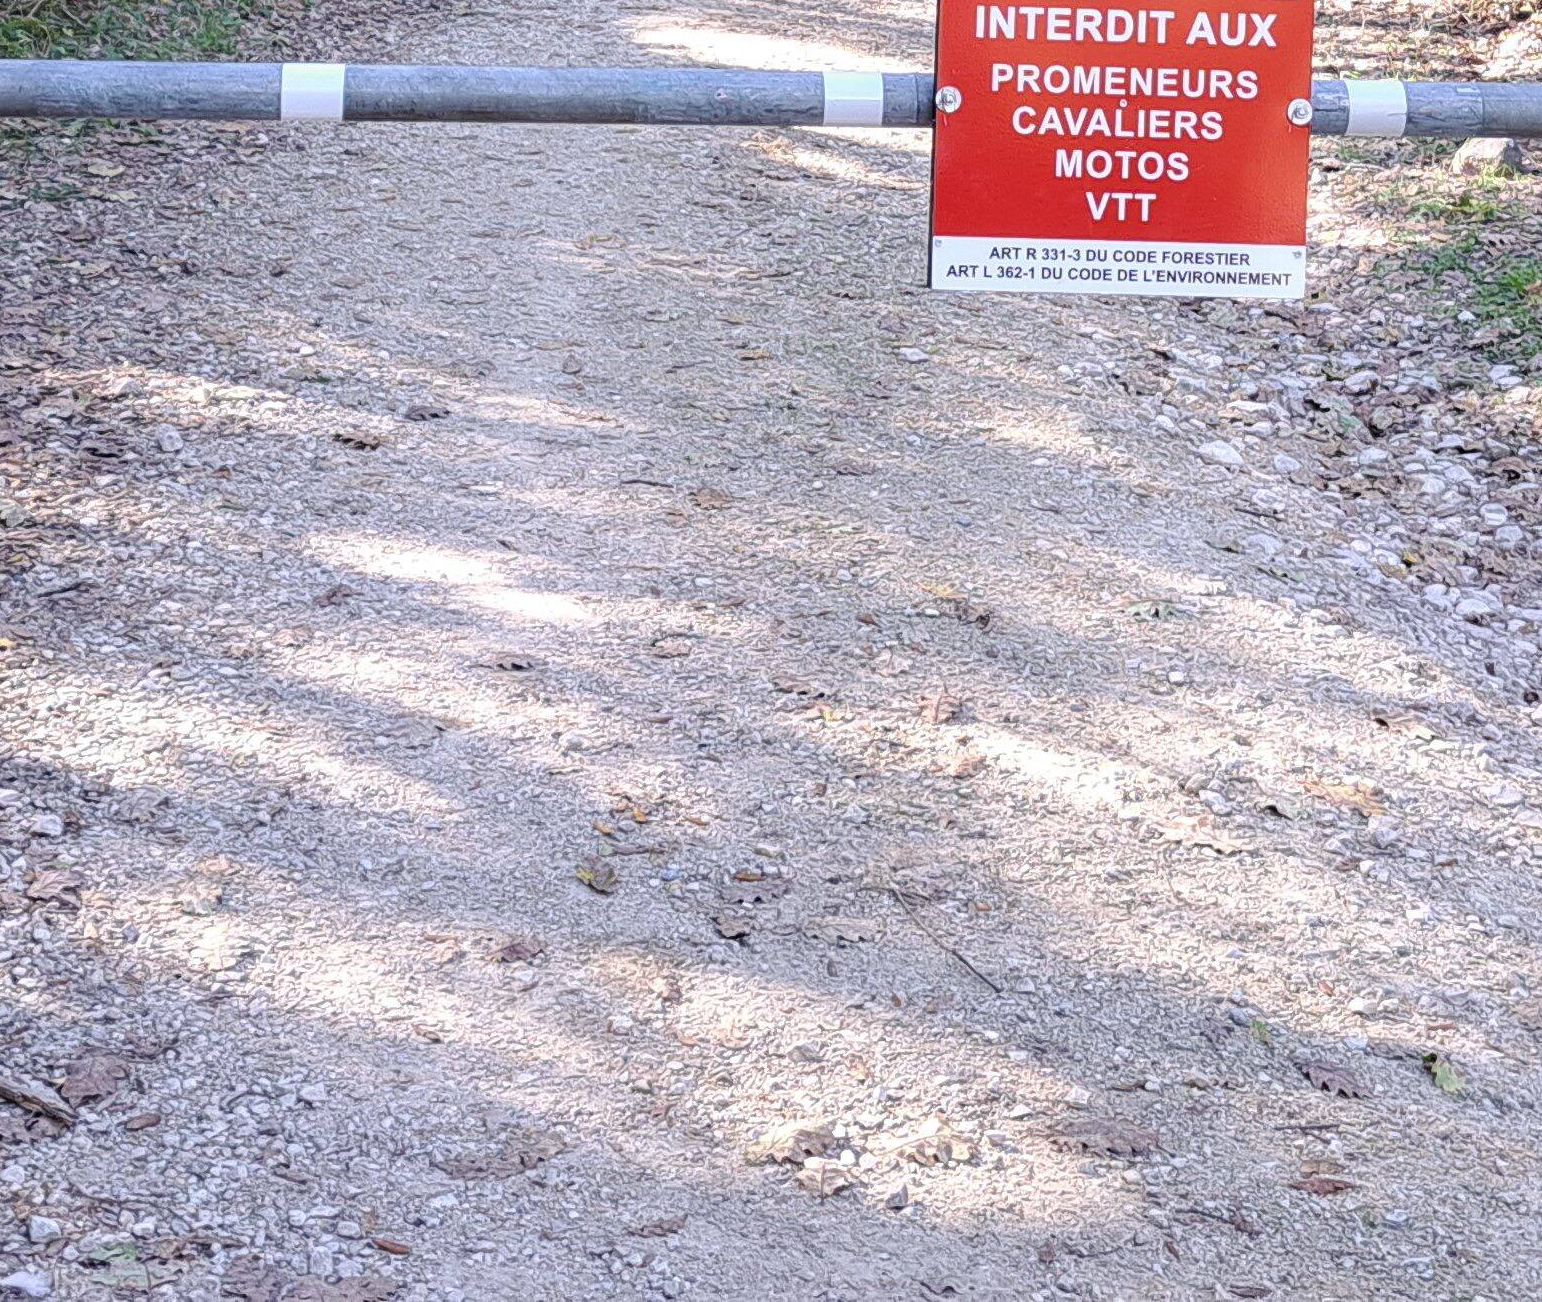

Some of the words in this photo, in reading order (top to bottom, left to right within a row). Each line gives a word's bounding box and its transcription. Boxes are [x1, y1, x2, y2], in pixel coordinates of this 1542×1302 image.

[975, 5, 1175, 43] INTERDIT
[1186, 12, 1278, 47] AUX
[991, 64, 1258, 99] PROMENEURS
[1012, 105, 1223, 140] CAVALIERS
[1055, 149, 1189, 181] MOTOS
[1085, 192, 1157, 222] VTT
[989, 246, 1022, 260] ART
[1026, 247, 1037, 260] R
[1041, 248, 1081, 262] 331-3
[1086, 249, 1108, 262] DU
[1112, 250, 1157, 264] CODE
[1162, 251, 1250, 266] FORESTIER
[946, 264, 979, 278] ART
[983, 266, 992, 278] L
[997, 266, 1035, 279] 362-1
[1041, 266, 1063, 280] DU
[1067, 267, 1112, 281] CODE
[1117, 269, 1138, 282] DE
[1143, 269, 1292, 286] L'ENVIRONNEMENT
